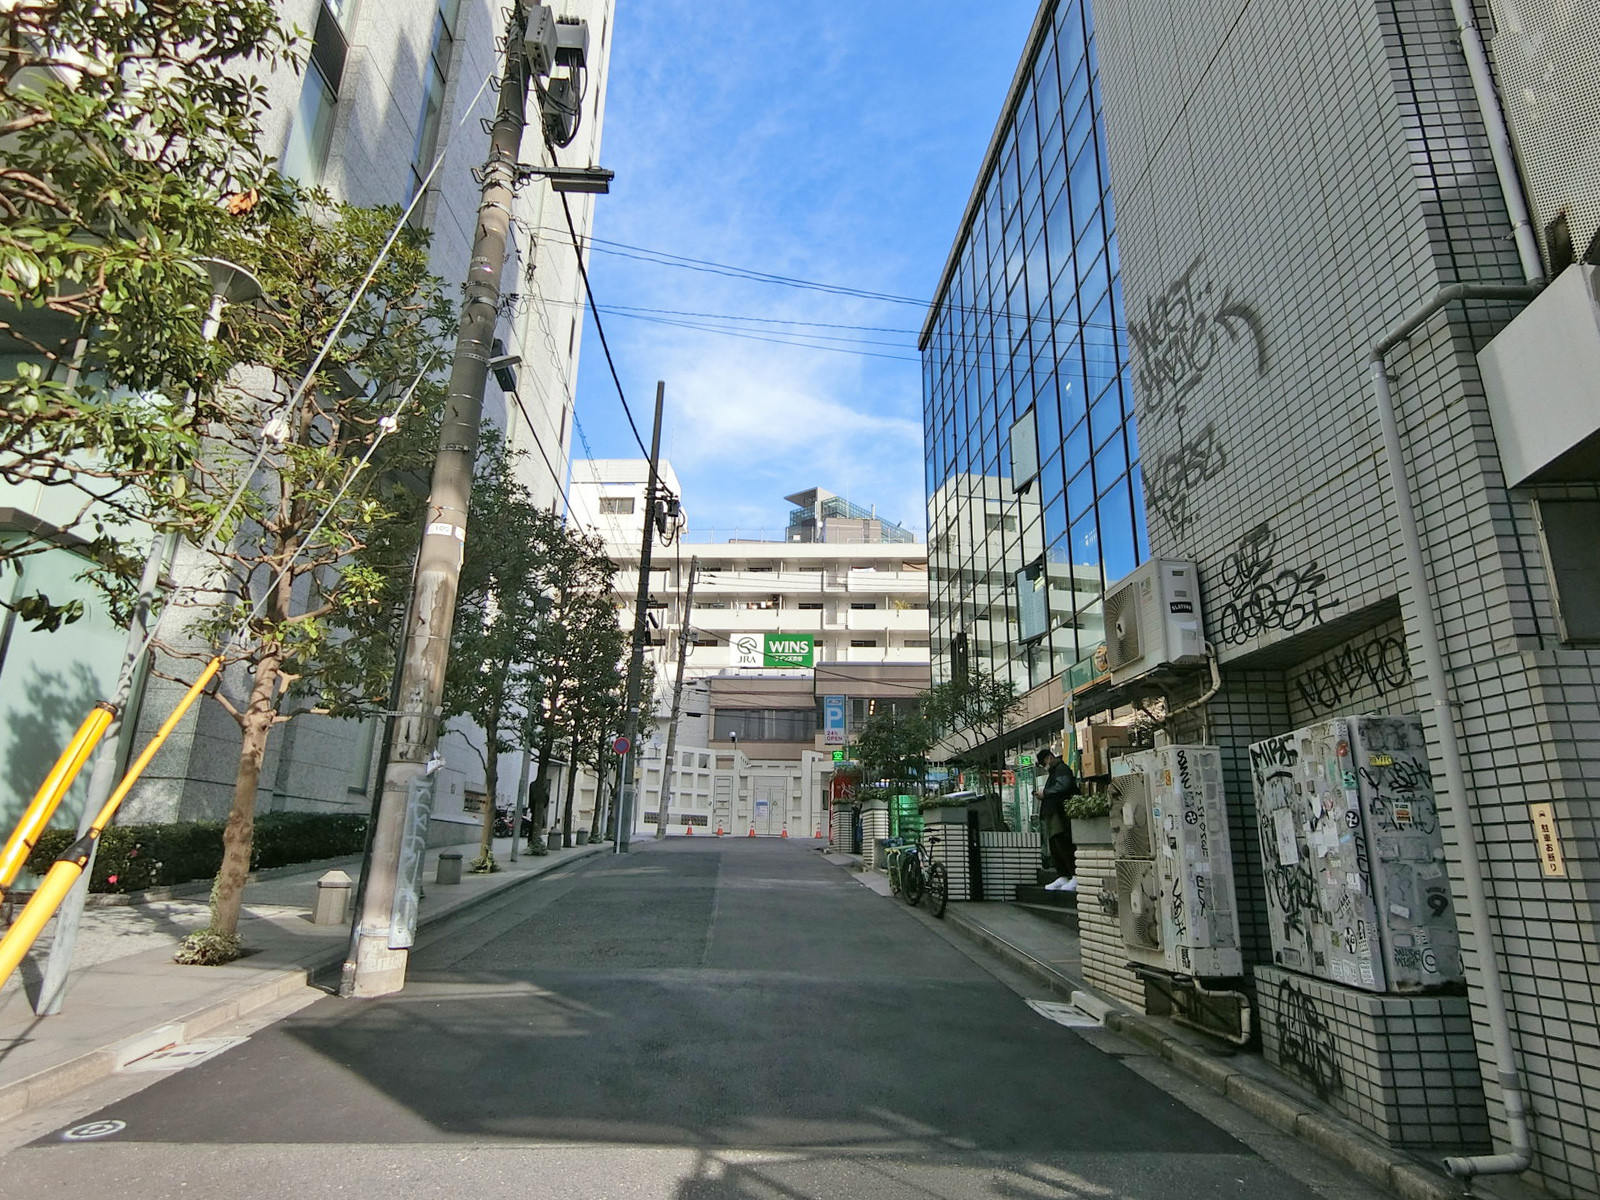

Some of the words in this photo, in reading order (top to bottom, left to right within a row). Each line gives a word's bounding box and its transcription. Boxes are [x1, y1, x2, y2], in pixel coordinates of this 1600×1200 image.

[768, 640, 809, 653] WINS
[737, 655, 756, 663] JRA
[826, 707, 843, 729] P
